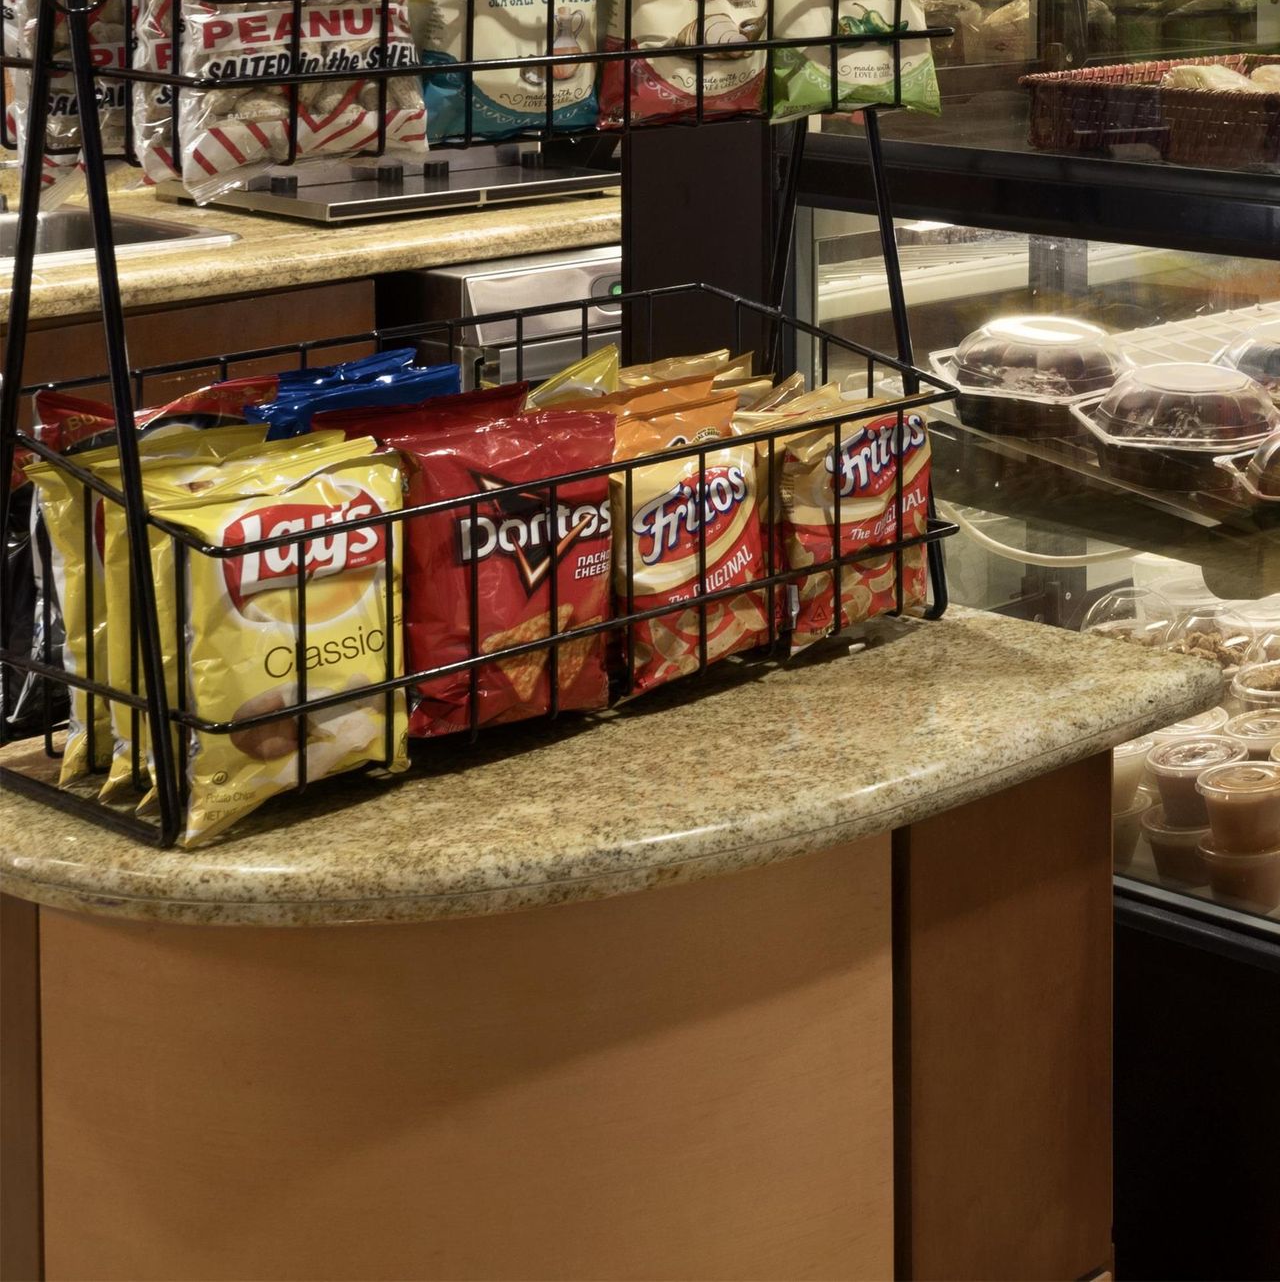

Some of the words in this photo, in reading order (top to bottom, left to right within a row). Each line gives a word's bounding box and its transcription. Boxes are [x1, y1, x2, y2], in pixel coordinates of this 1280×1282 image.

[208, 51, 292, 79] SALTED
[300, 51, 320, 74] in
[328, 47, 360, 71] the
[825, 414, 927, 497] Fritos
[240, 502, 379, 590] Lay's
[631, 466, 747, 566] Fritos
[851, 528, 871, 541] The
[264, 625, 386, 679] Cassic
